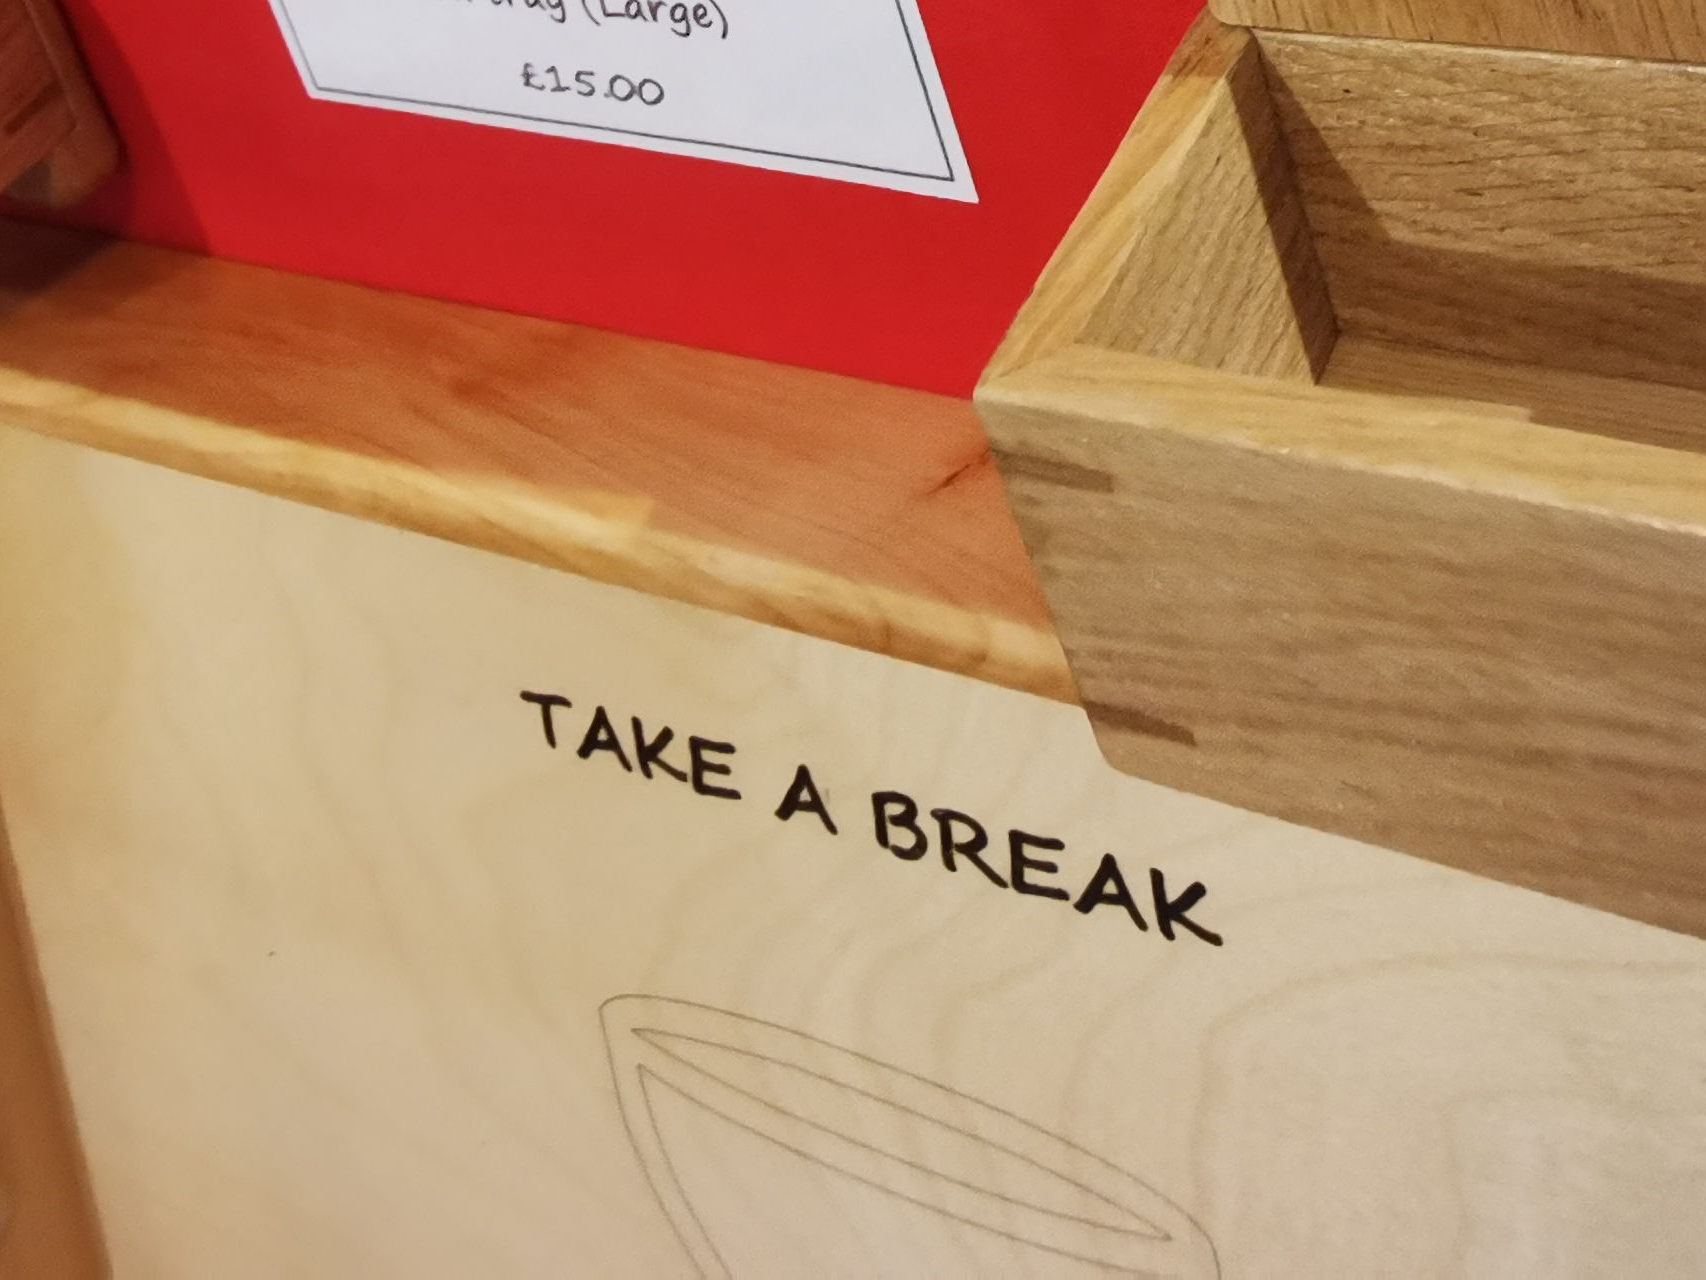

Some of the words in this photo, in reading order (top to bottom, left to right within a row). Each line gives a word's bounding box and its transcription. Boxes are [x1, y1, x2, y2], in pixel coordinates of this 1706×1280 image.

[521, 62, 665, 107] £15.00
[519, 690, 742, 800] TAKE
[775, 764, 839, 835] A
[871, 790, 1224, 947] BREAK
